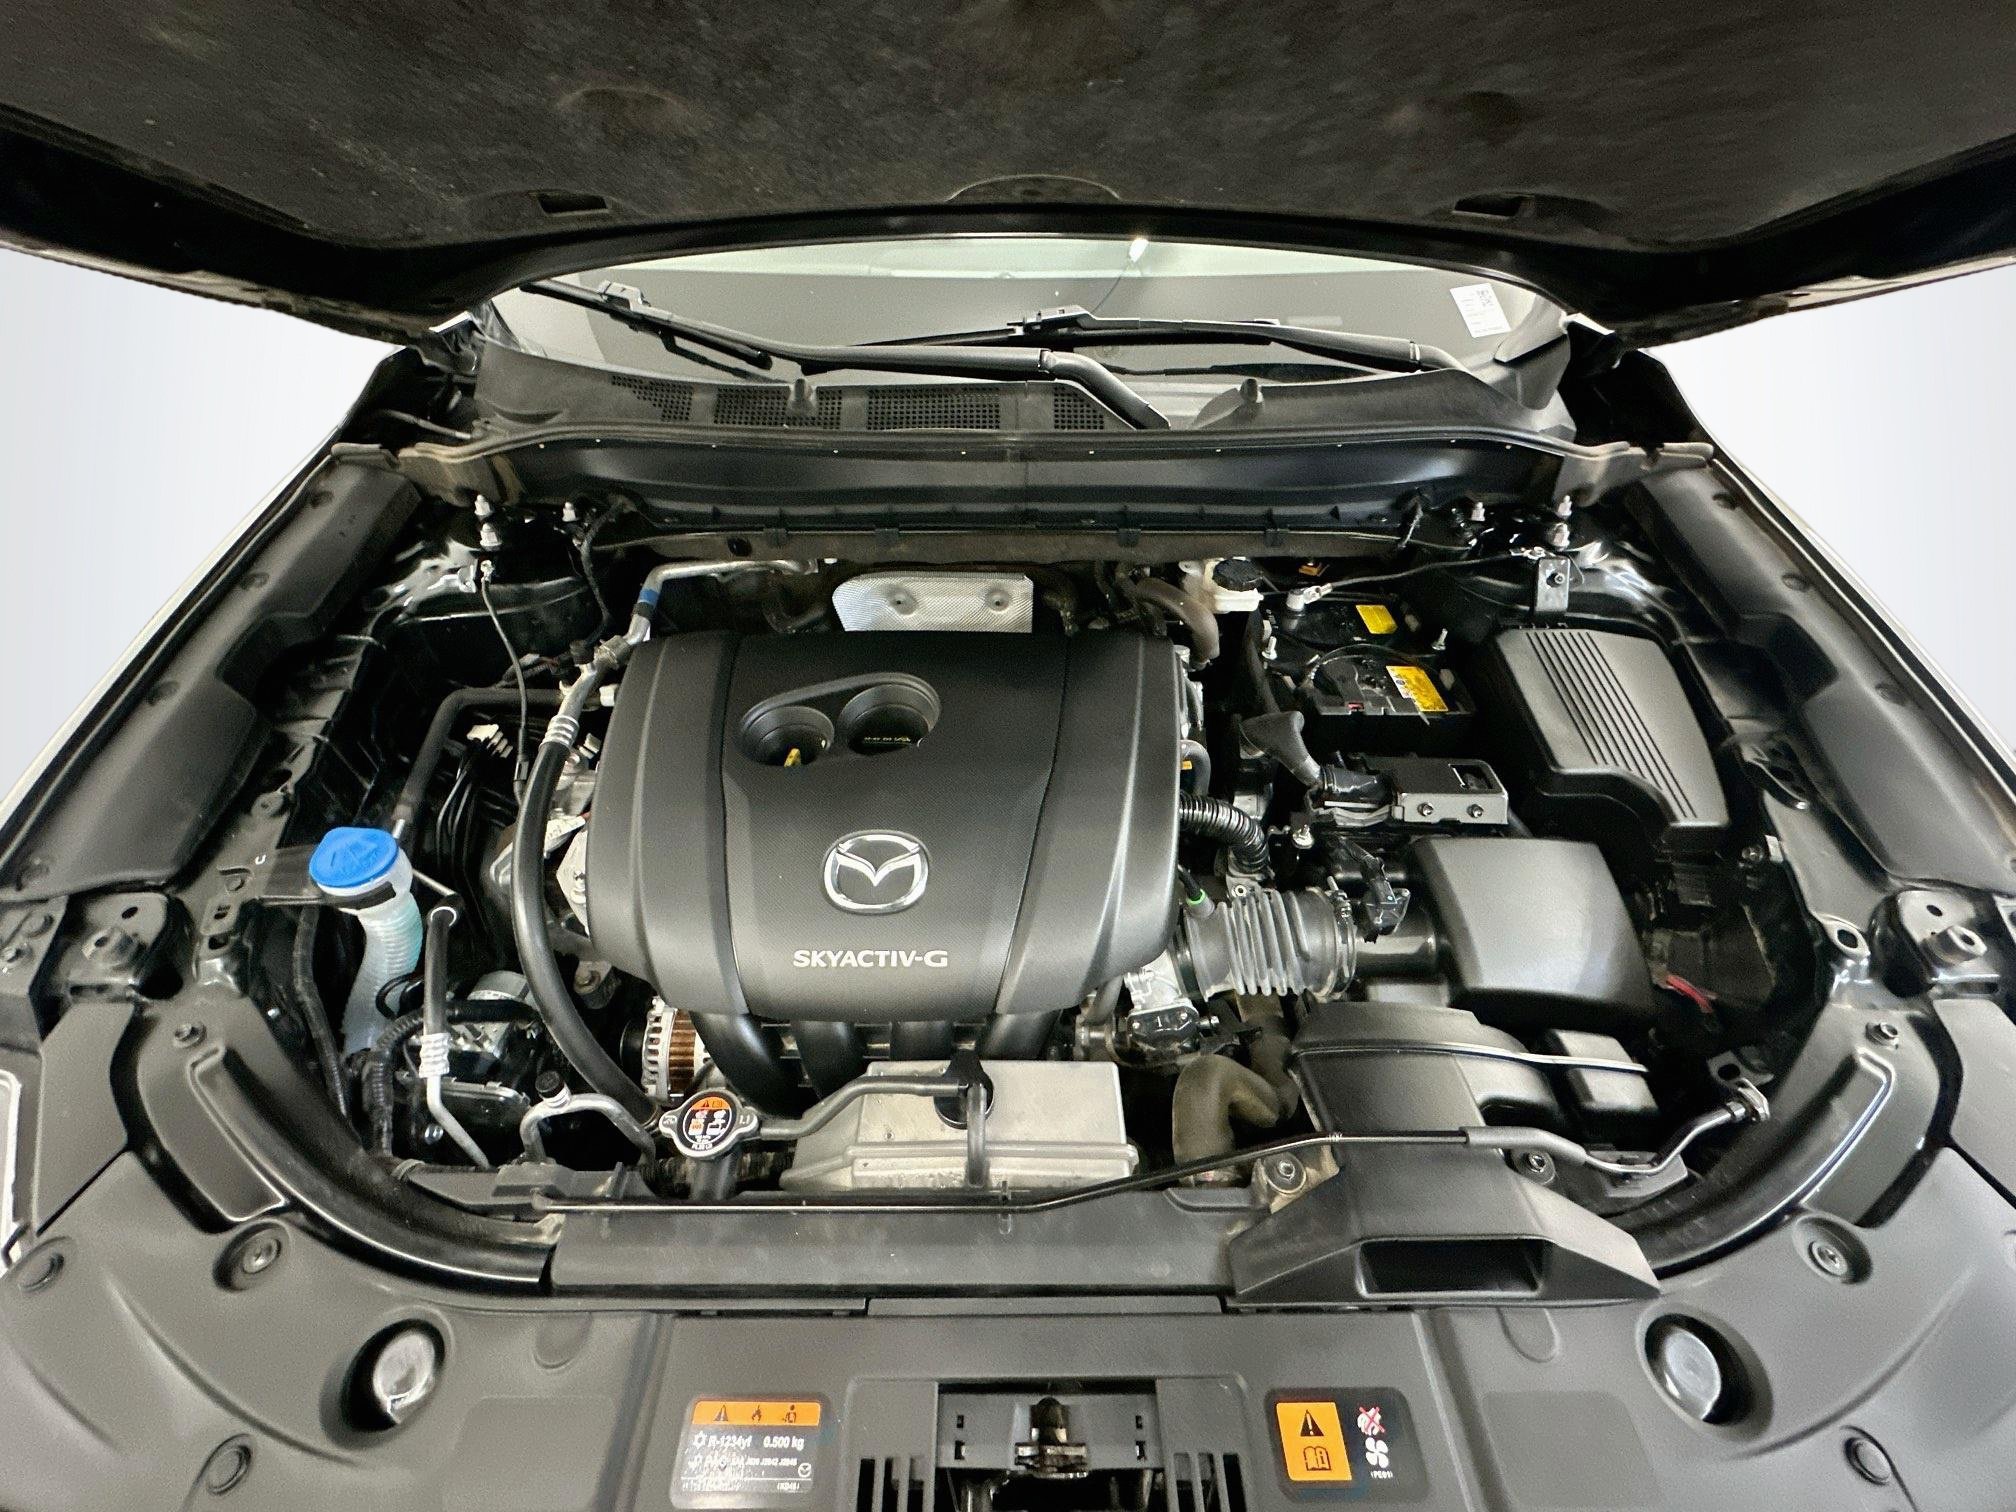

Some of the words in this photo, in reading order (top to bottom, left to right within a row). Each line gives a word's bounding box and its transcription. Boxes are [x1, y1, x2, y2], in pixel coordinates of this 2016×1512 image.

[792, 949, 948, 968] SKYACTIV-G
[763, 1435, 790, 1448] 0.500
[790, 1436, 805, 1451] kg
